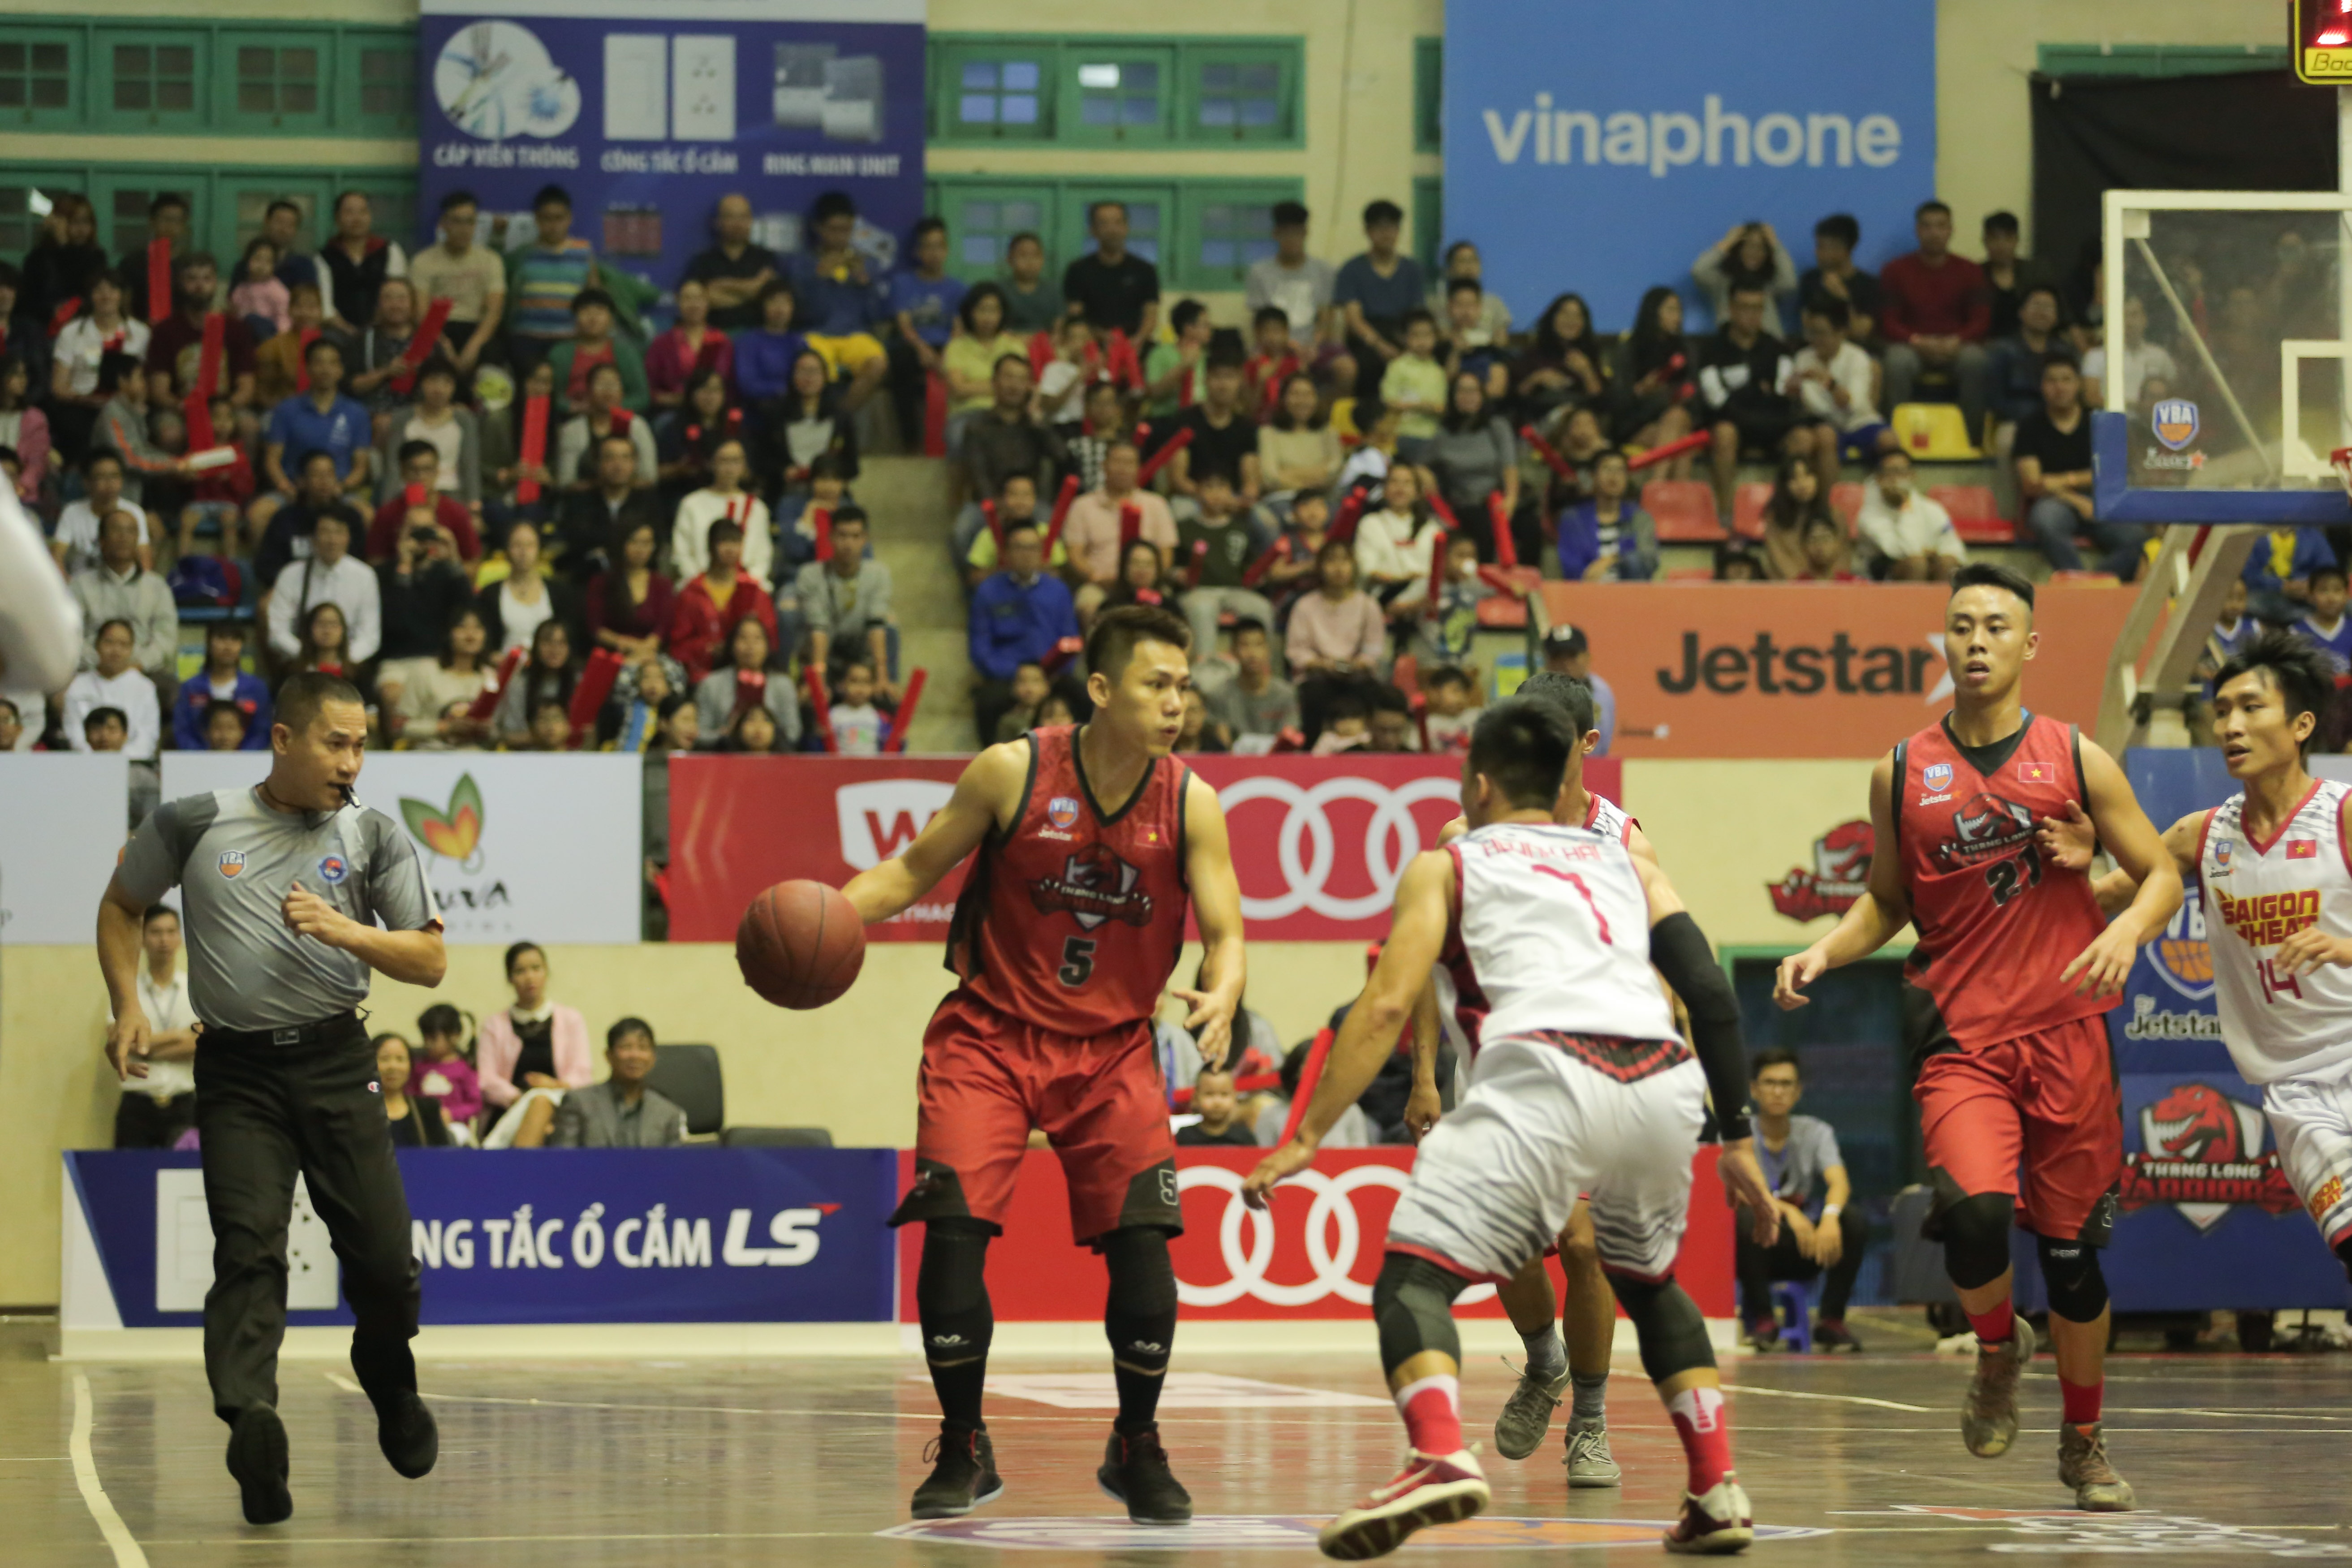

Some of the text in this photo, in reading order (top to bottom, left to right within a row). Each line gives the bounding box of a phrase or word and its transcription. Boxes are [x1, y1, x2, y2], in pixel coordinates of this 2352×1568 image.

[1482, 92, 1902, 178] vinaphone
[2159, 405, 2193, 424] VBA
[1656, 632, 1934, 695] Jetstar
[1927, 766, 1949, 778] VBA
[1054, 800, 1074, 813] VBA
[222, 852, 244, 864] VBA
[1985, 843, 2042, 907] 21
[2219, 889, 2320, 925] SAIGON
[1057, 935, 1096, 987] 5
[2257, 958, 2303, 1004] 14
[1158, 1168, 1179, 1206] 5
[2143, 1162, 2261, 1179] THANG LONG
[411, 1202, 713, 1268] NG TẮC Ổ CẮM
[722, 1208, 822, 1267] LS
